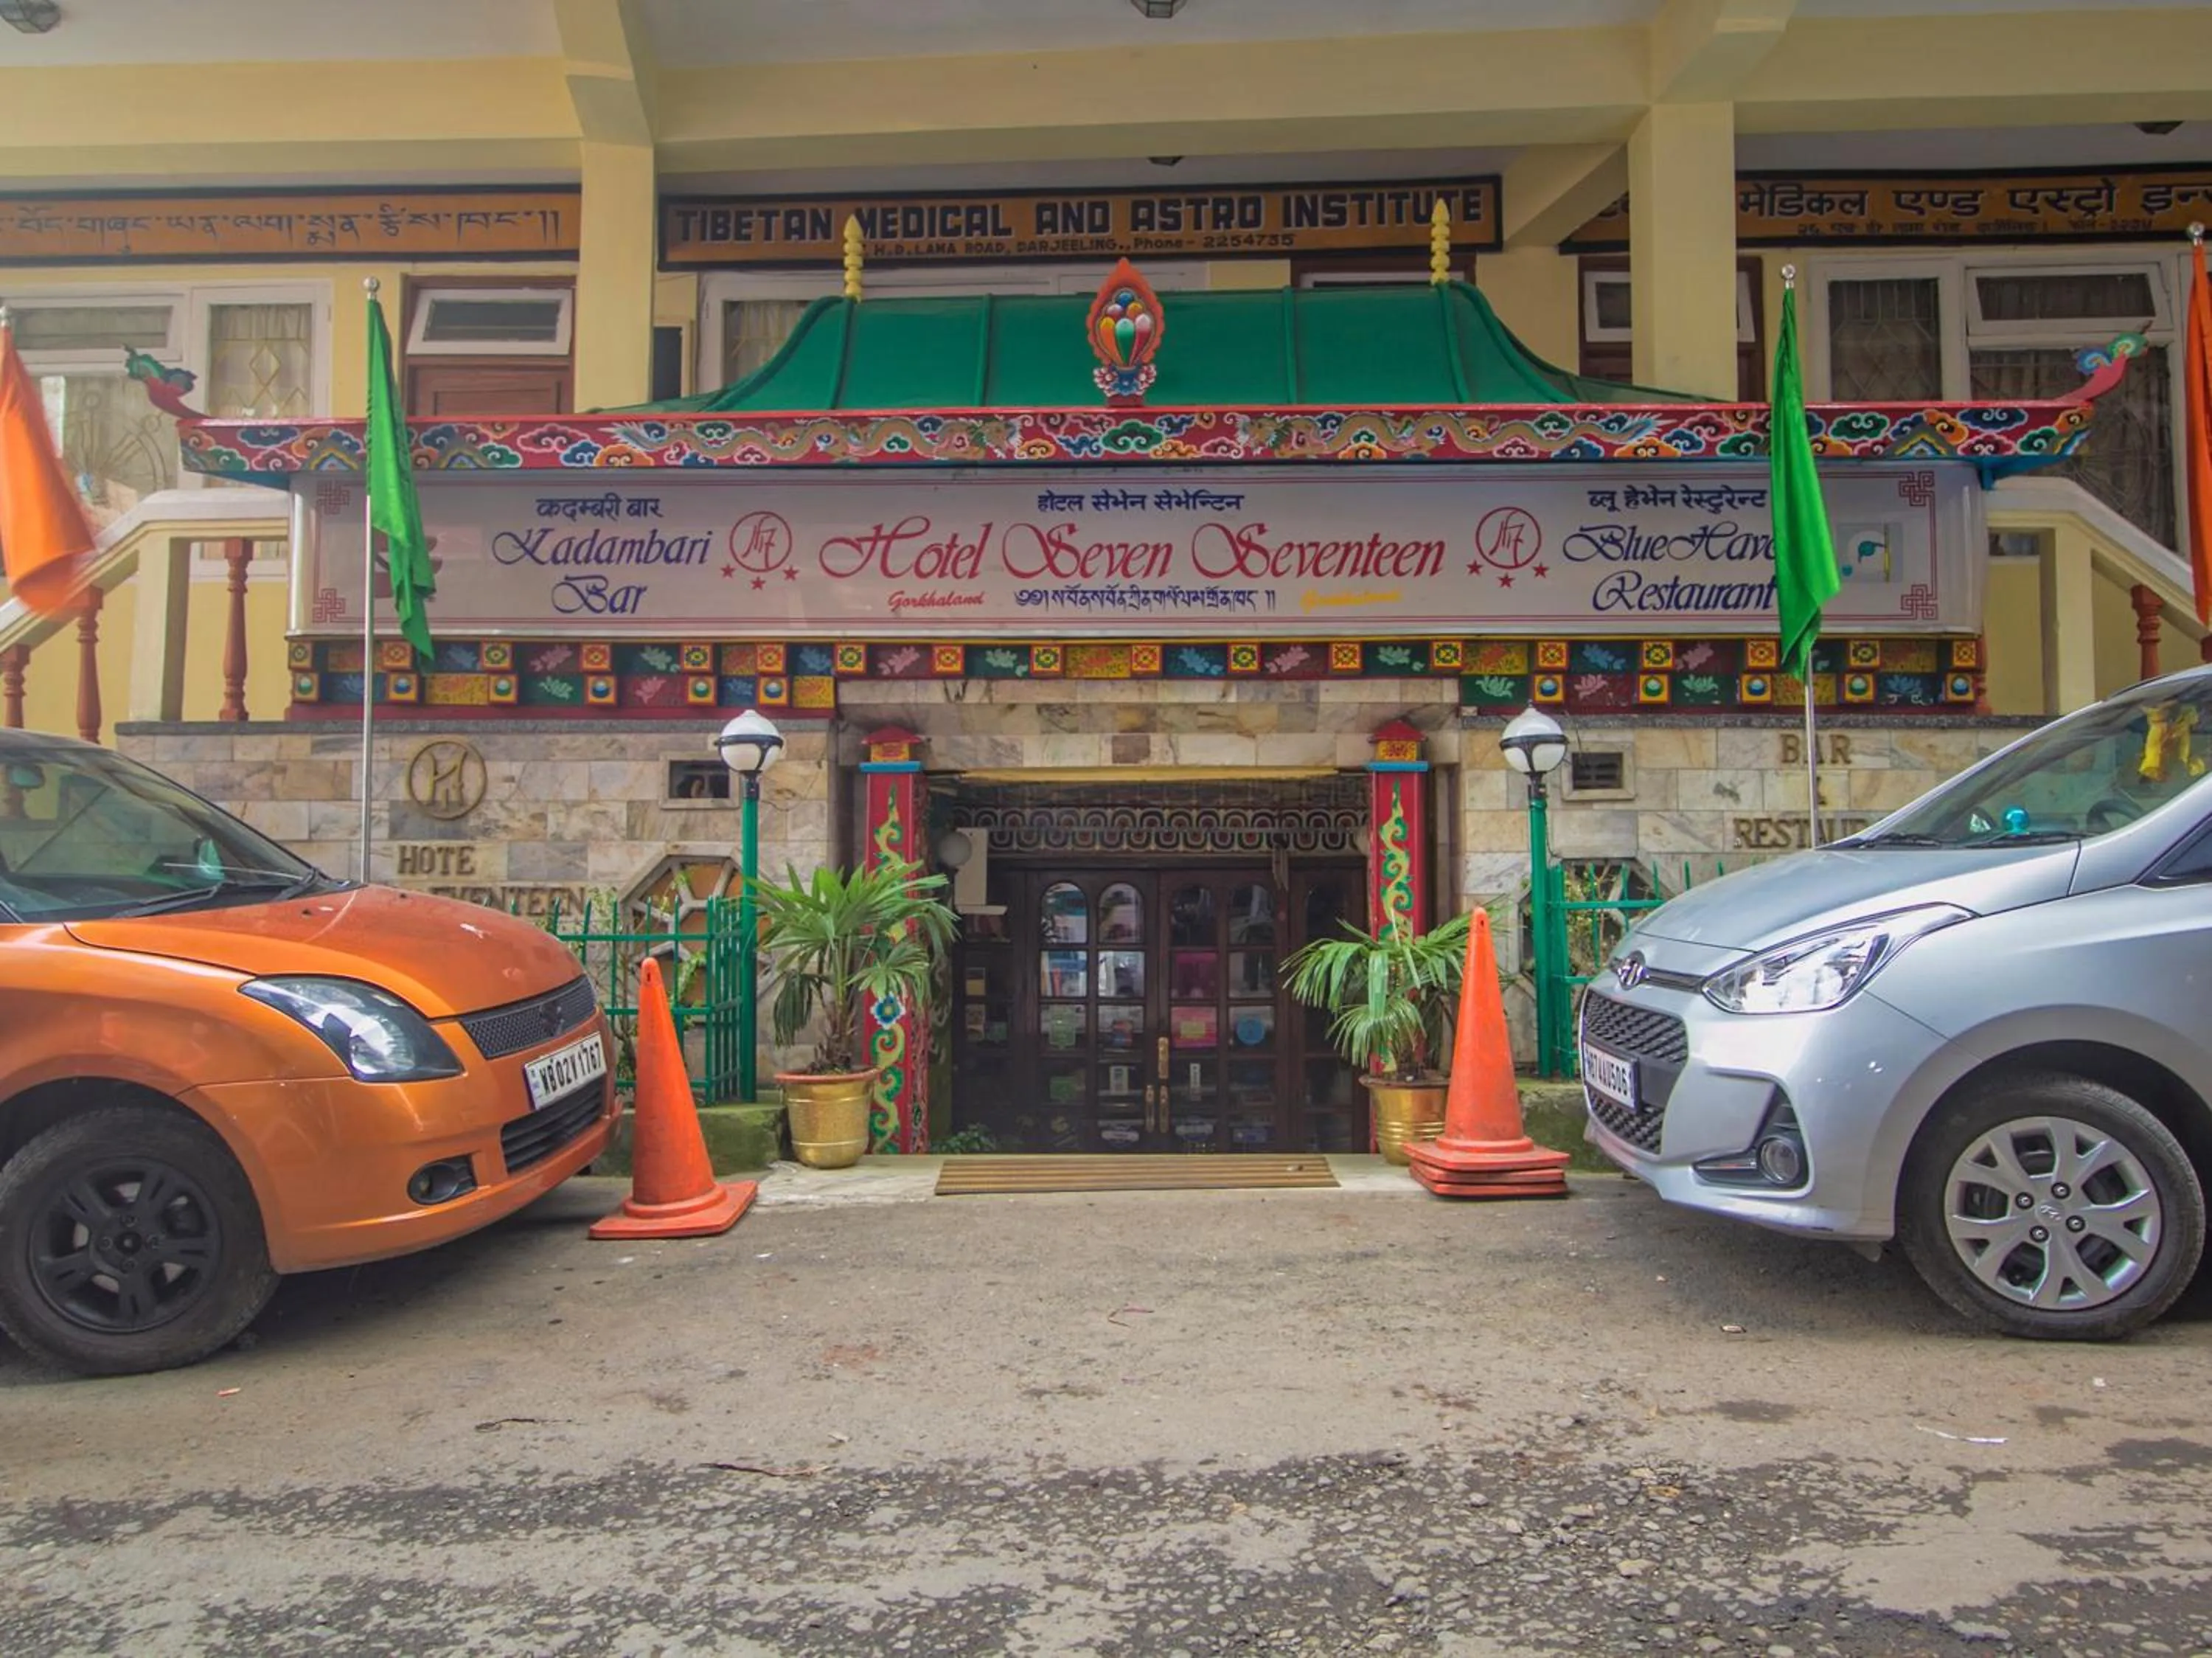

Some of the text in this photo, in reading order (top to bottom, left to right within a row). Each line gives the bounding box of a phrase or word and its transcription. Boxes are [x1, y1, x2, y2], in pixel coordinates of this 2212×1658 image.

[676, 189, 1483, 242] TIBETAN MEDICAL AND ASTRO INSTITUTE
[1739, 178, 2212, 219] मेडिकल एण्ड एस्ट्रो इन्
[536, 492, 664, 521] कदम्बरी बार
[1037, 490, 1084, 512] होटल
[1092, 489, 1147, 512] सेभेन
[1624, 484, 1677, 509] हेभेन
[493, 528, 714, 566] Kadambari
[819, 515, 1447, 580] Hotel Seven Seventeen
[552, 575, 648, 615] Bar
[1593, 570, 1778, 611] Restaurant
[1779, 732, 1852, 765] BAR
[398, 844, 476, 876] HOTE
